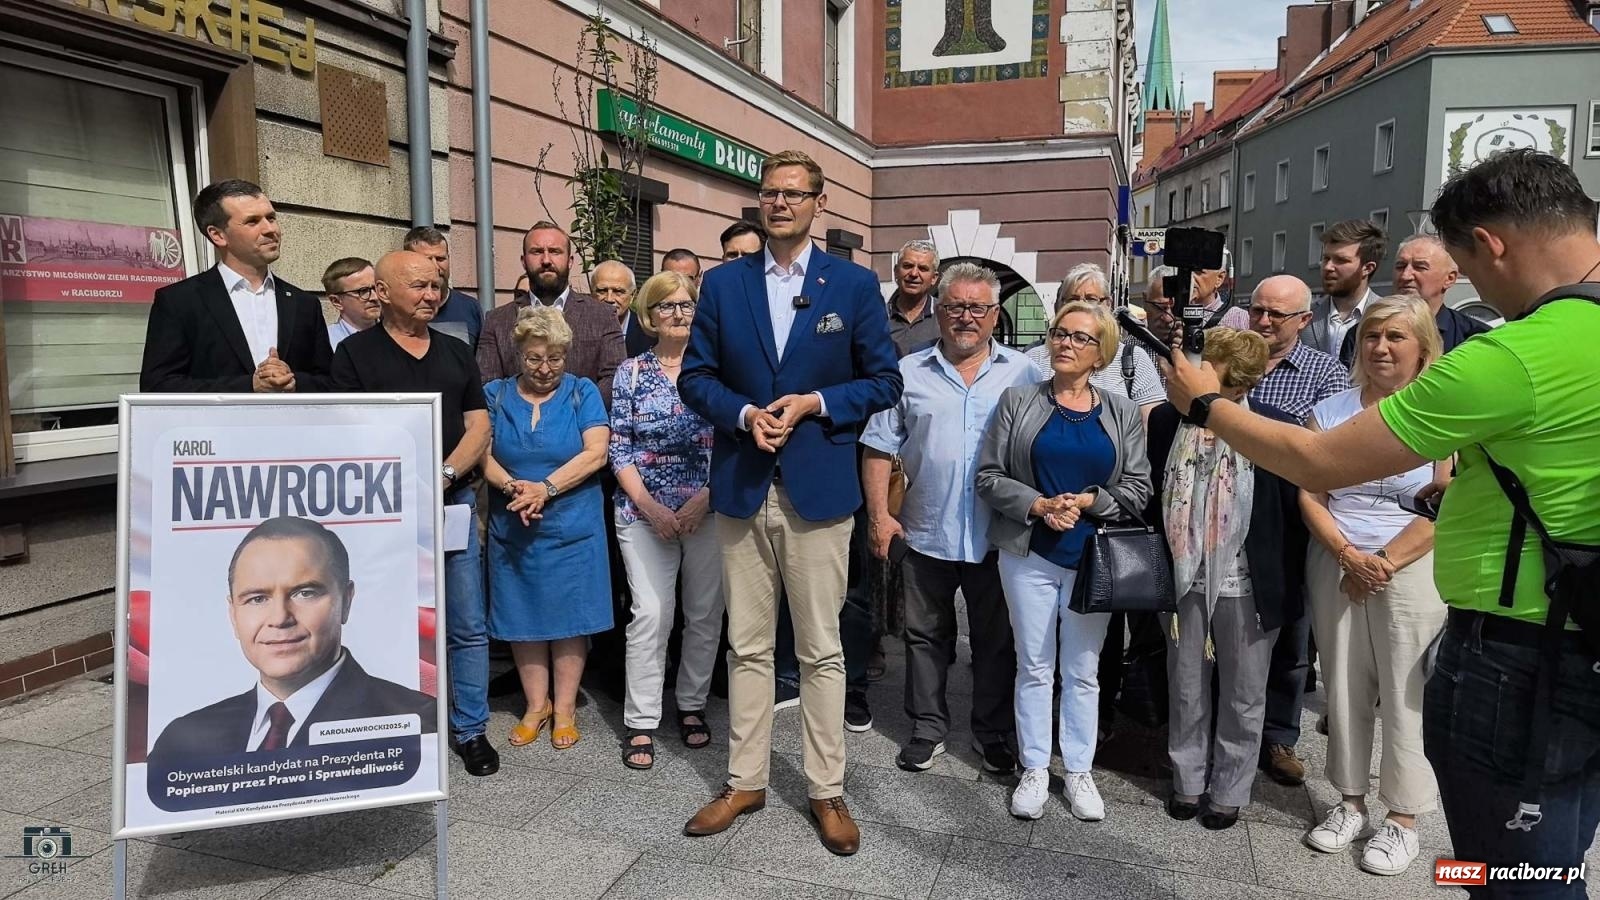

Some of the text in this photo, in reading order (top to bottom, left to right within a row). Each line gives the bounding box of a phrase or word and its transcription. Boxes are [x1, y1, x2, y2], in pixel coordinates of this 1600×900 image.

[53, 270, 106, 280] MIŁOŚNIKÓW
[72, 289, 122, 298] RACIBORZU
[173, 440, 216, 456] KAROL
[172, 462, 403, 522] NAWROCKI
[320, 722, 411, 736] KAROLNAWROCKI2025.pl
[167, 747, 403, 783] Obywatelski kandydat na Prezydenta RP
[166, 760, 404, 797] Popierany przez Prawo i Sprawiedliwość
